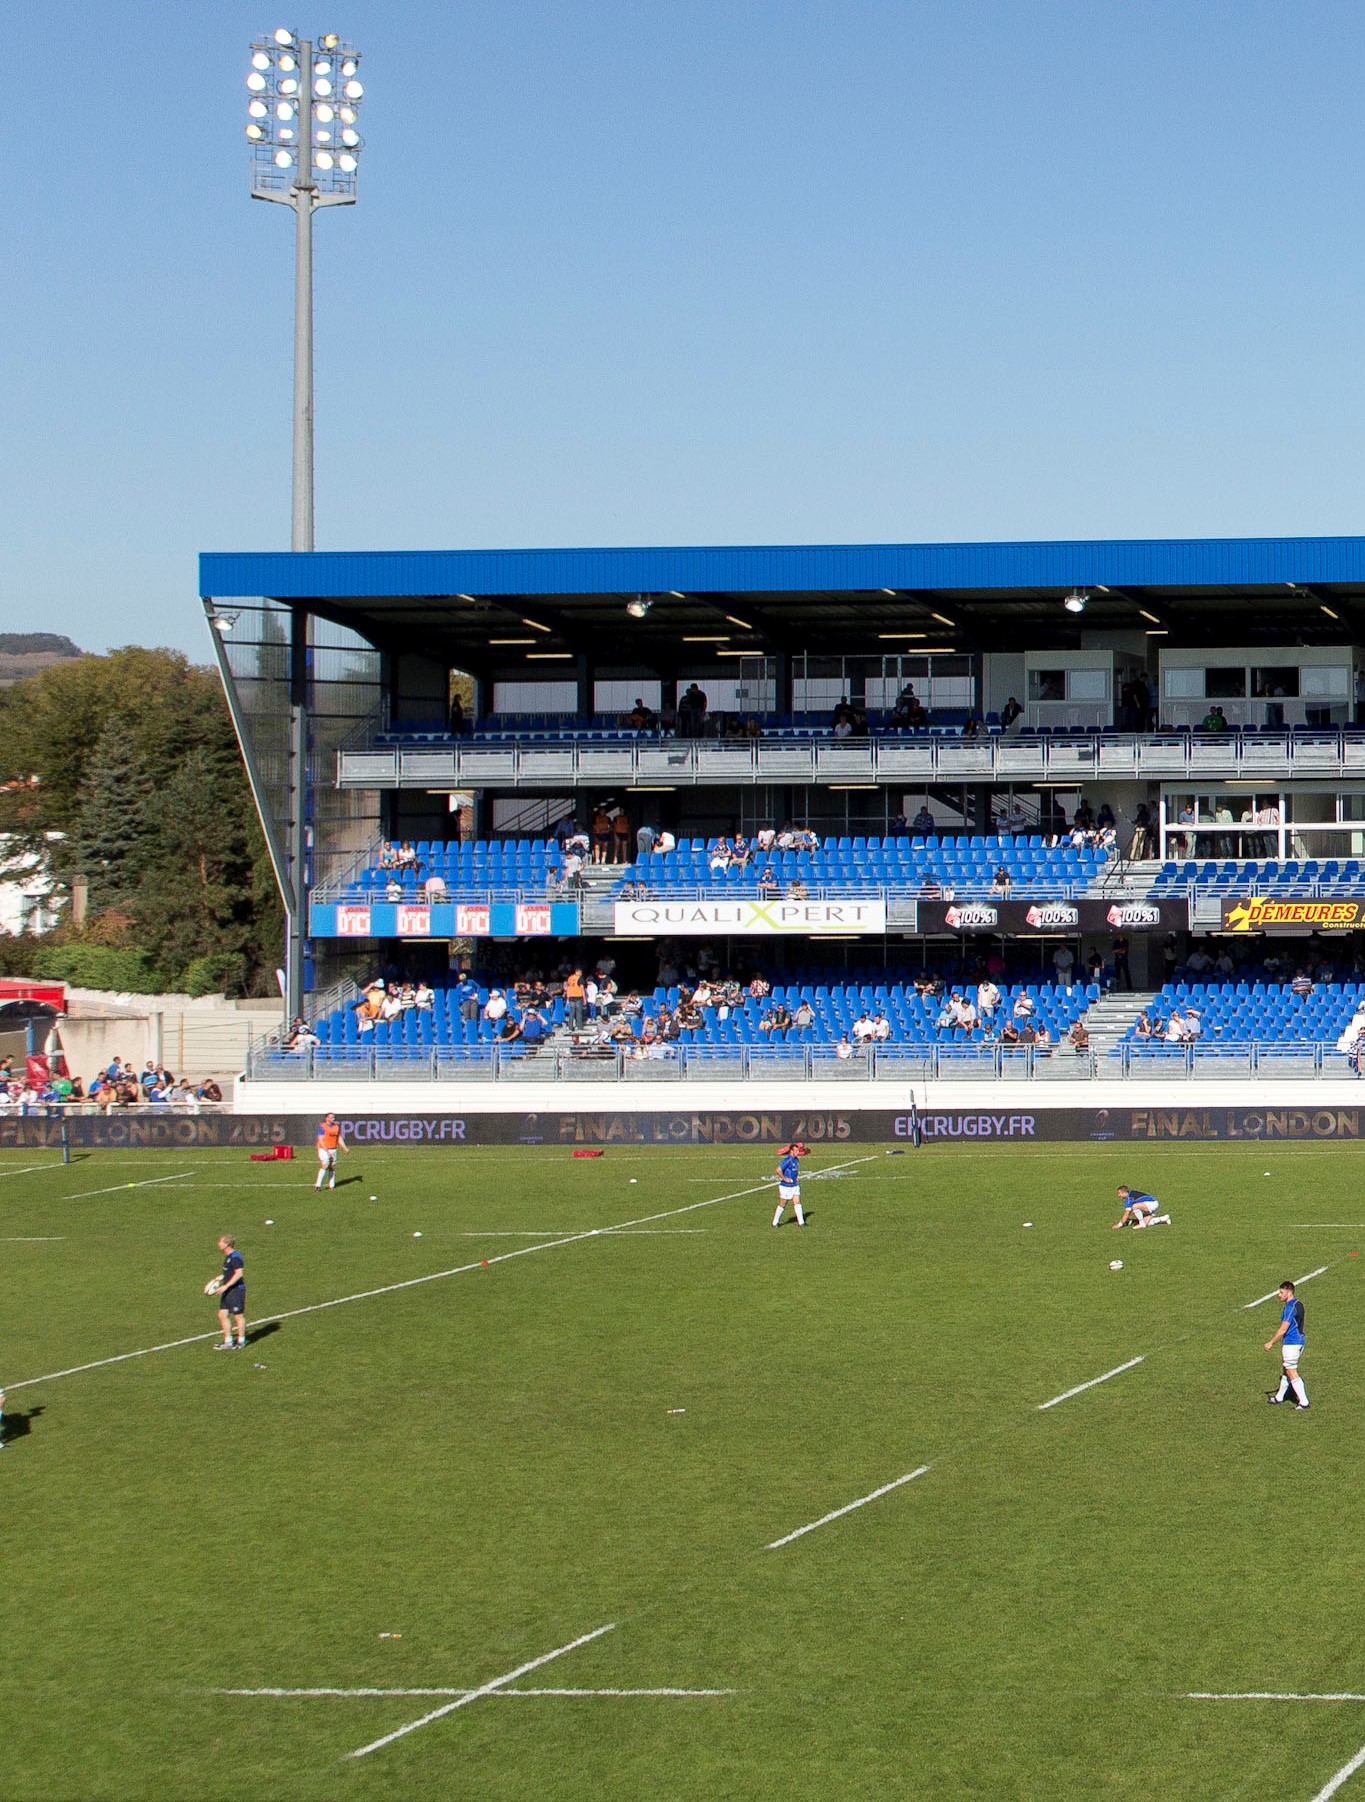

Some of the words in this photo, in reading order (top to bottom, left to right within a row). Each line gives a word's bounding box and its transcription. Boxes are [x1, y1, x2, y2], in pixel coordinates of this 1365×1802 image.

[1, 1118, 83, 1144] FINAL
[92, 1118, 219, 1142] LONDON
[229, 1118, 286, 1142] 2015
[336, 1120, 466, 1139] PCRUGBY.FR
[560, 1116, 645, 1140] FINAL
[654, 1115, 782, 1140] LONDON
[791, 1115, 852, 1139] 2015
[894, 1116, 1036, 1136] EPCRUGBY.FR
[1131, 1112, 1218, 1136] FINAL
[1227, 1111, 1359, 1136] LONDON
